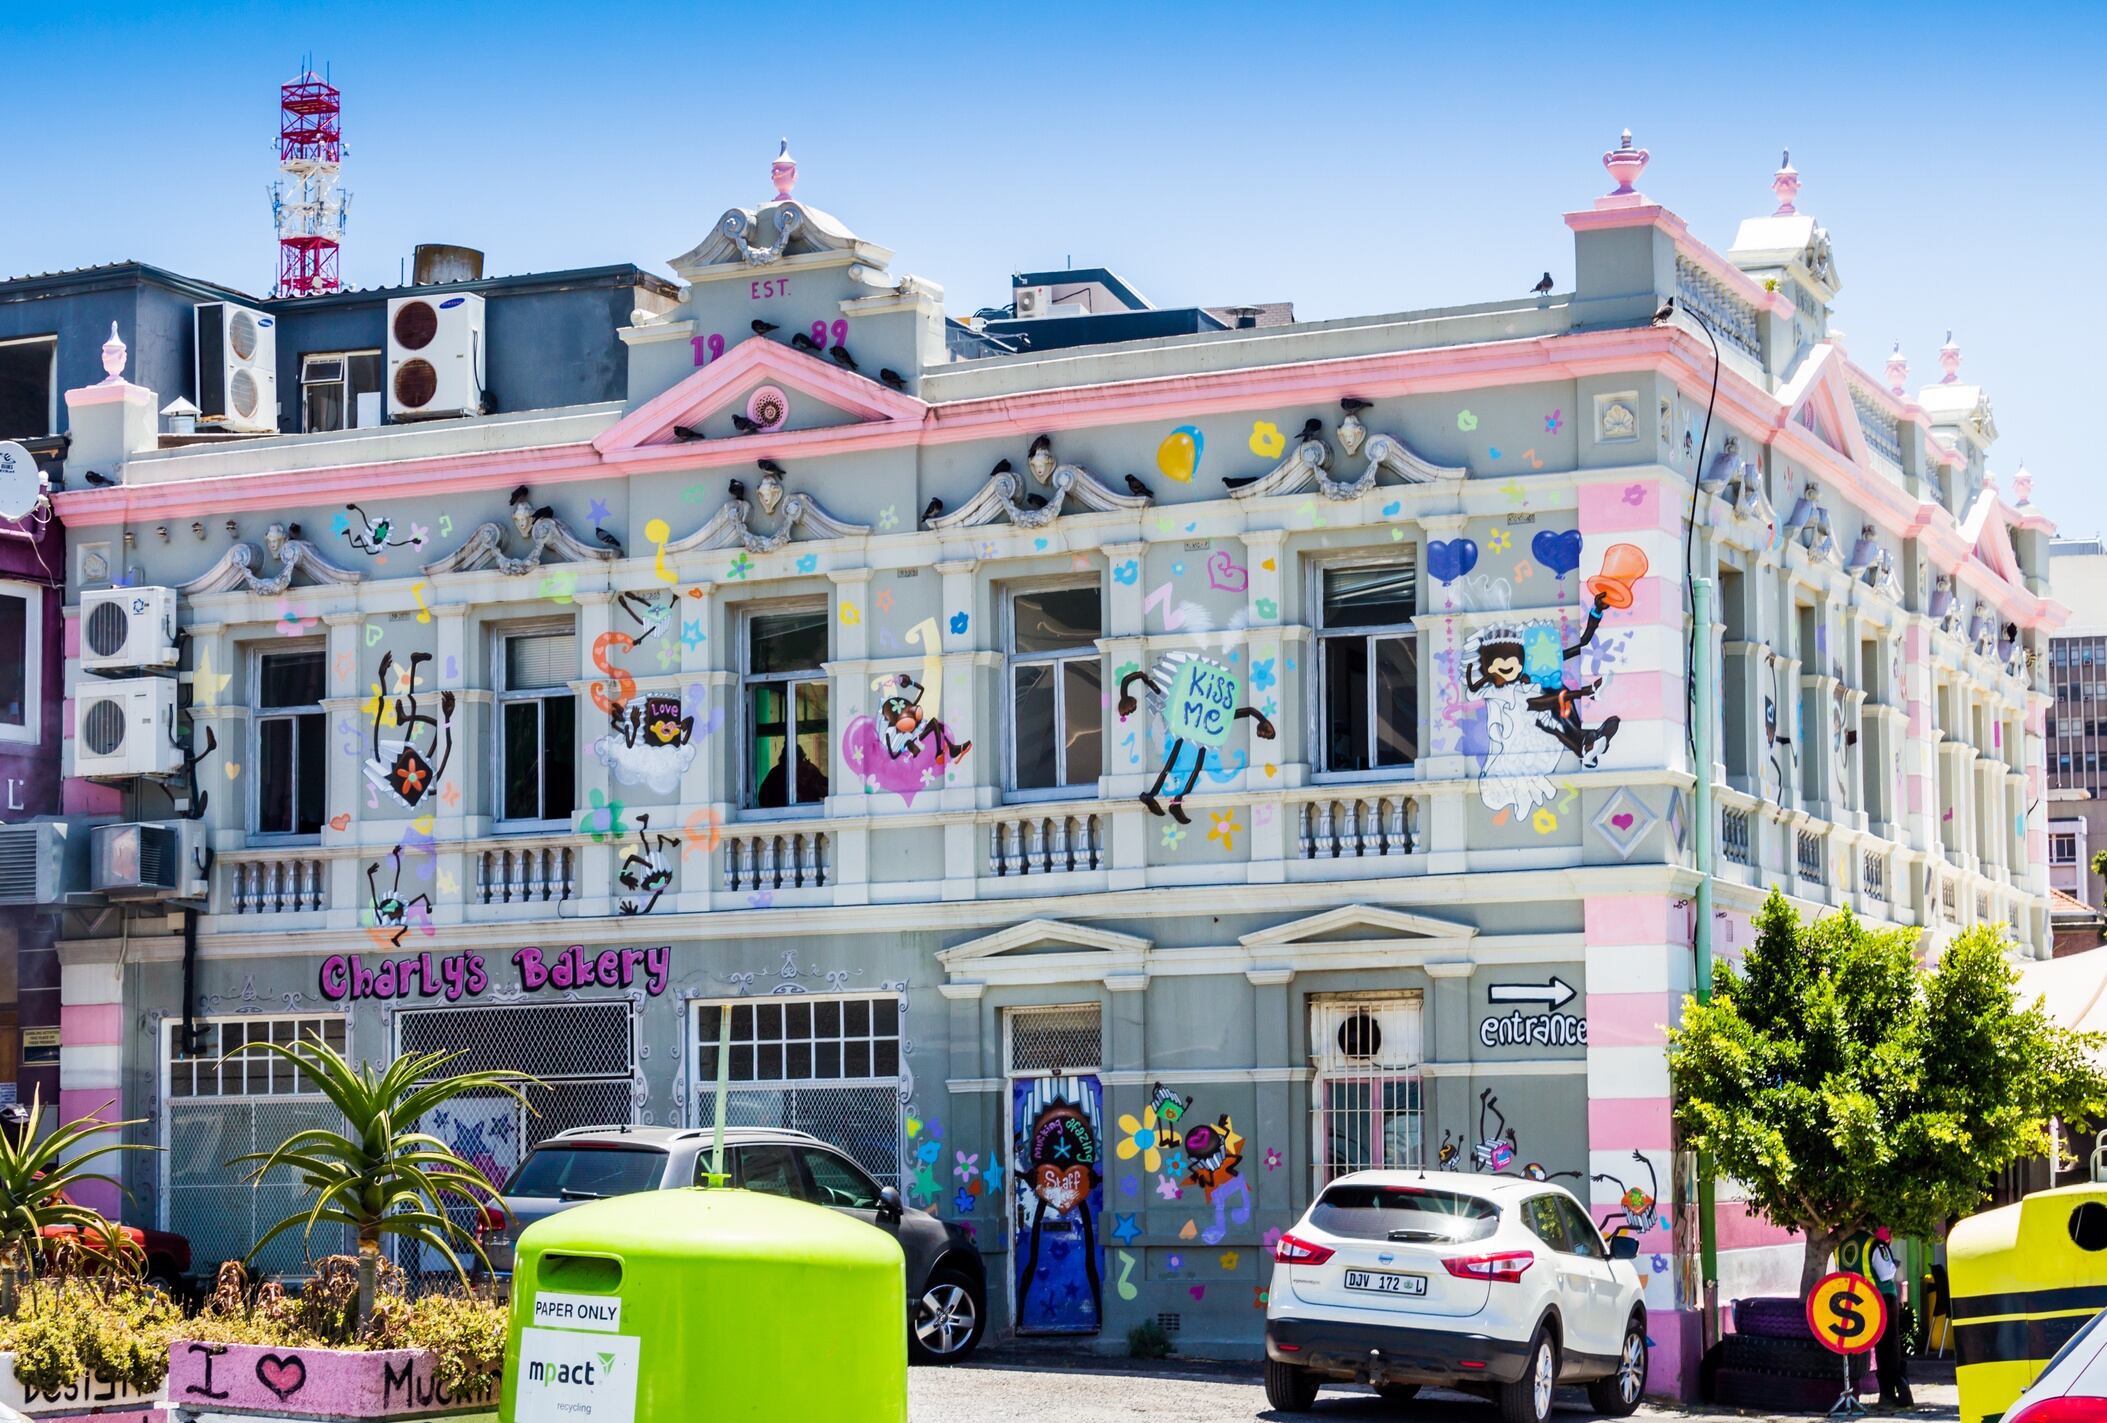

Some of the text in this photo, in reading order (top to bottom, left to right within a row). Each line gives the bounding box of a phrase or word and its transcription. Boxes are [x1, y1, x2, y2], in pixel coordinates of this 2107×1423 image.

[751, 278, 792, 300] EST.
[690, 319, 849, 367] 19 89
[1183, 701, 1225, 736] Me
[512, 944, 671, 997] Bakery
[1480, 1009, 1588, 1048] entrance
[1044, 1170, 1081, 1190] Staff
[1348, 1272, 1423, 1293] DJV 172 L
[535, 1301, 617, 1321] PAPER ONLY
[1828, 1290, 1866, 1338] S
[529, 1361, 595, 1387] mpact
[557, 1402, 592, 1416] recycling
